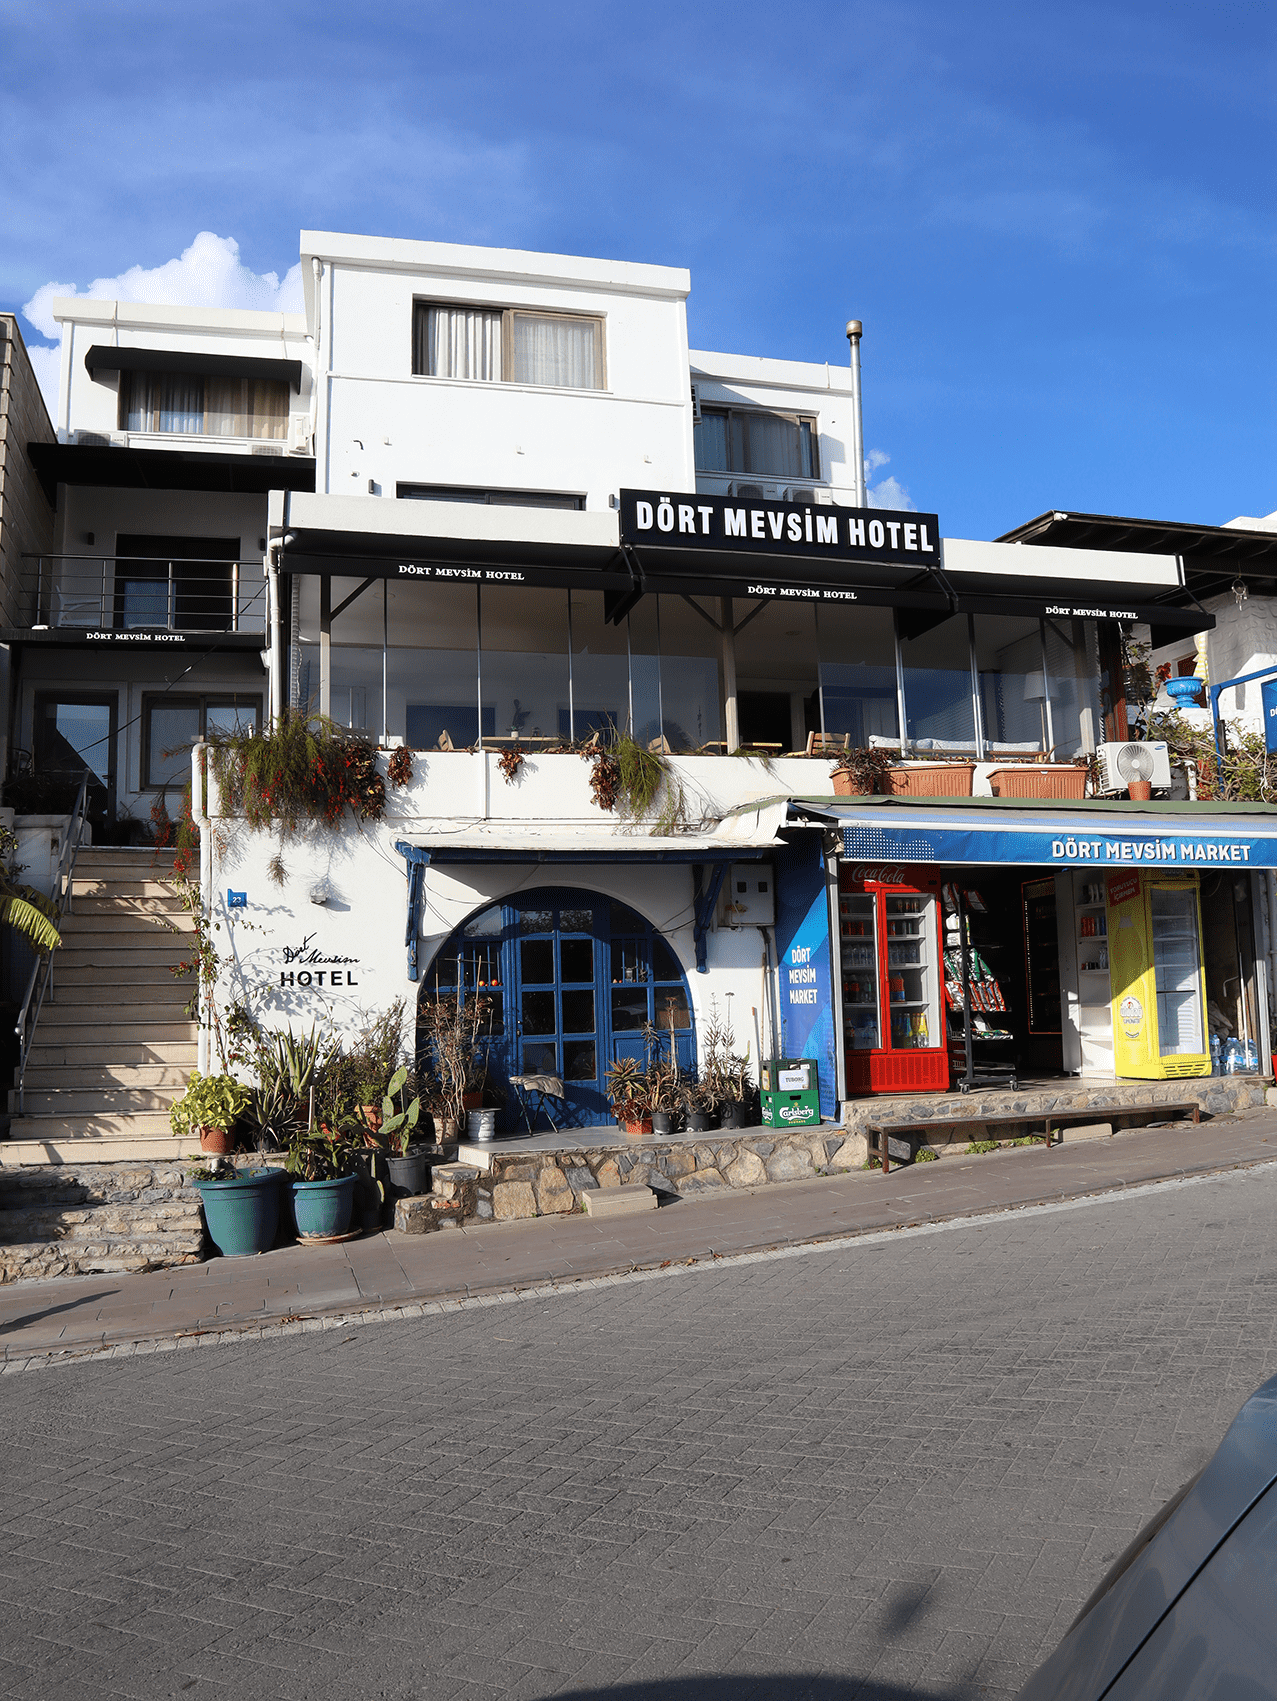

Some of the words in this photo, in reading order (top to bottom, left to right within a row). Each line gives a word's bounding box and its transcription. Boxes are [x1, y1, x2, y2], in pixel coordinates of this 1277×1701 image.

[636, 497, 713, 534] DÖRT
[724, 508, 838, 544] MEVSİM
[848, 518, 934, 552] HOTEL
[398, 565, 432, 576] DÖRT
[435, 567, 482, 578] MEVSİM
[485, 571, 525, 581] HOTEL
[747, 584, 777, 595] DÖRT
[779, 588, 821, 598] MEVSİM
[823, 590, 858, 600] HOTEL
[1045, 605, 1071, 615] DÖRT
[1072, 608, 1108, 618] MEVSİM
[1109, 611, 1139, 620] HOTEL
[86, 631, 113, 640] DÖRT
[115, 632, 152, 641] MEVSİM
[154, 634, 186, 642] HOTEL
[1051, 837, 1102, 859] DÖRT
[1105, 839, 1177, 861] MEVSİM
[1180, 843, 1251, 862] MARKET
[282, 932, 317, 965] Dört
[299, 948, 361, 964] Mevsim
[791, 945, 811, 964] DÖRT
[280, 970, 359, 987] HOTEL
[788, 964, 817, 984] MEVSİM
[789, 988, 818, 1004] MARKET
[778, 1105, 814, 1121] Carlsberg
